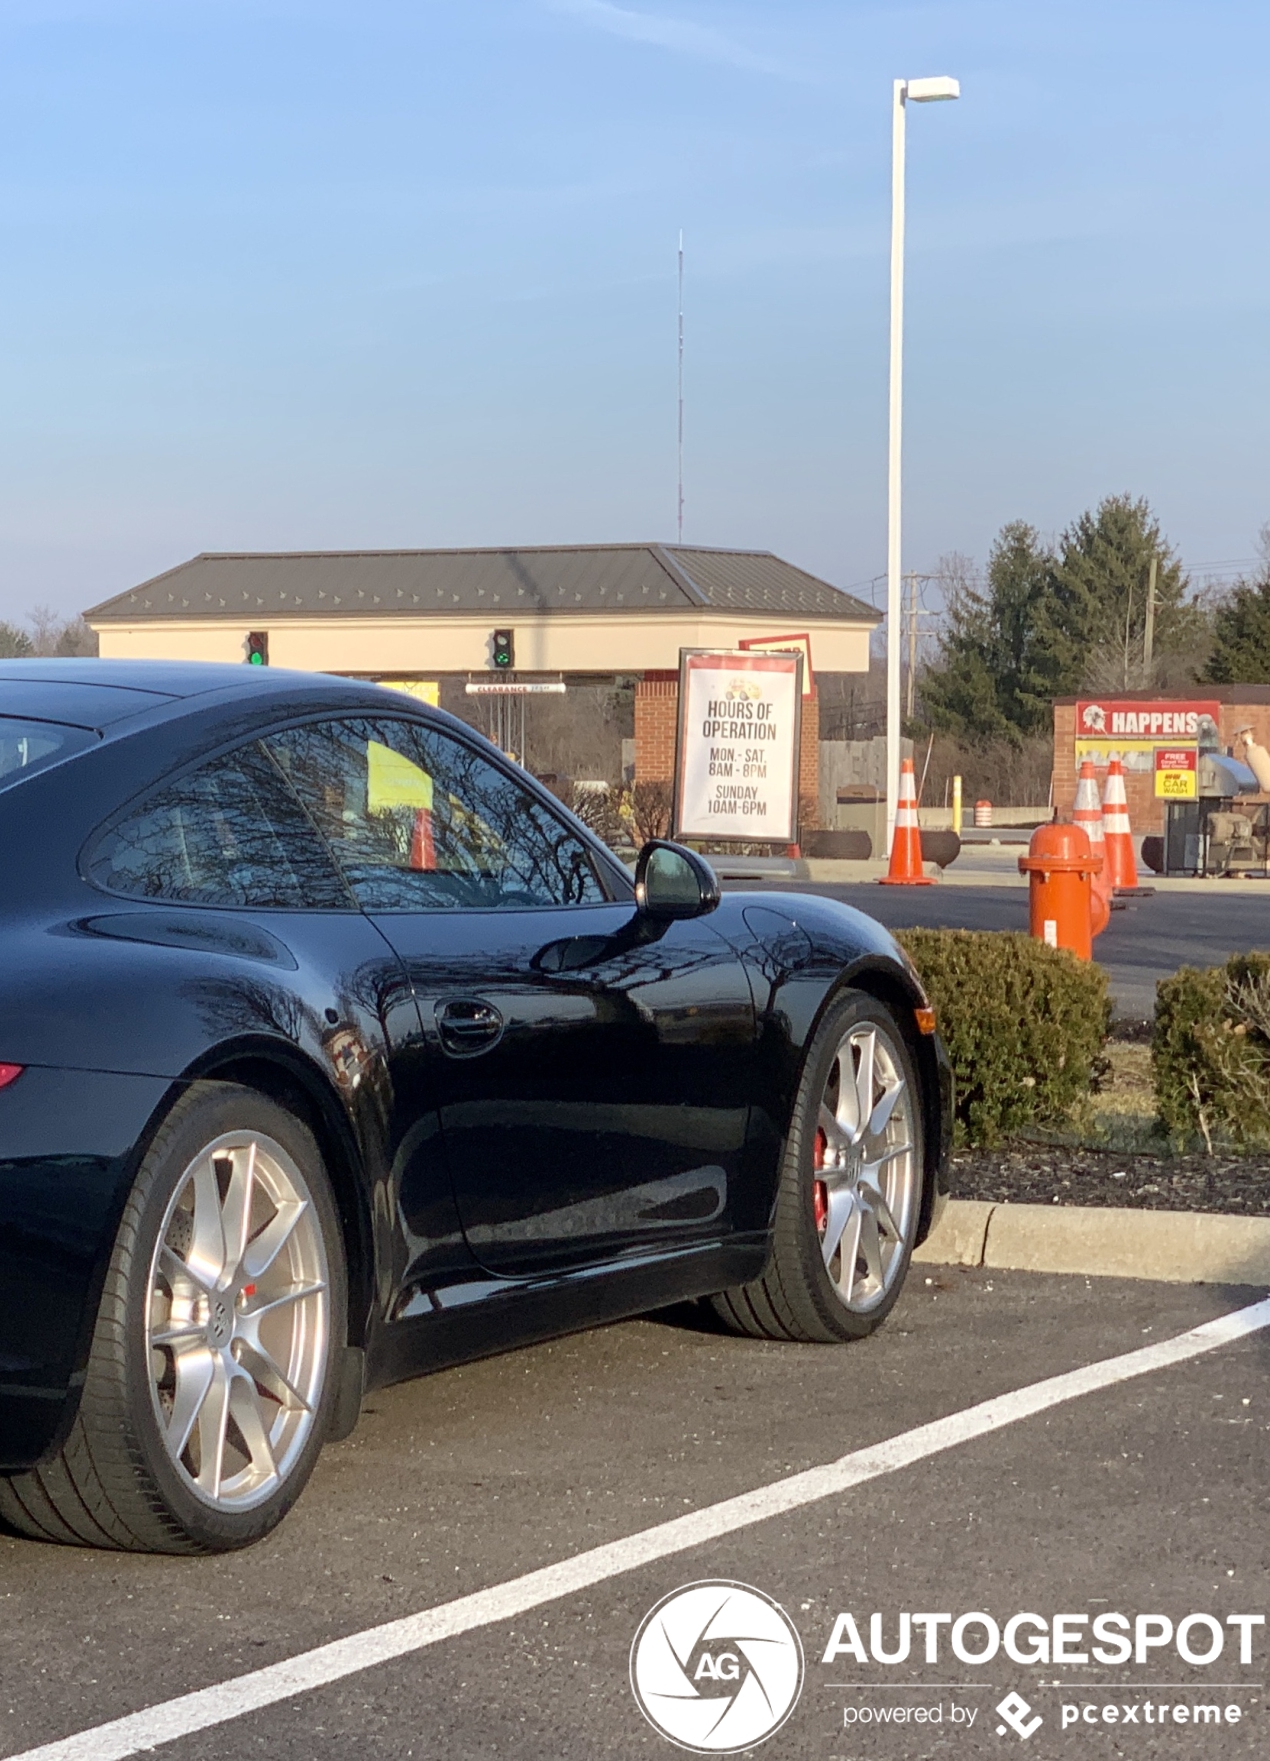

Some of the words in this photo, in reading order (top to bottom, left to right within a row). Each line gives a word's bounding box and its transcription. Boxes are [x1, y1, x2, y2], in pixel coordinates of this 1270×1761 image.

[708, 700, 753, 720] HOURS
[757, 702, 773, 721] OF
[702, 720, 777, 741] OPERATION
[1112, 711, 1198, 734] HAPPENS
[745, 749, 767, 764] SAT.
[1164, 753, 1187, 761] FREE
[709, 762, 733, 778] 8AM
[743, 763, 767, 779] 8PM
[716, 784, 758, 800] SUNDAY
[1163, 780, 1188, 788] CAR
